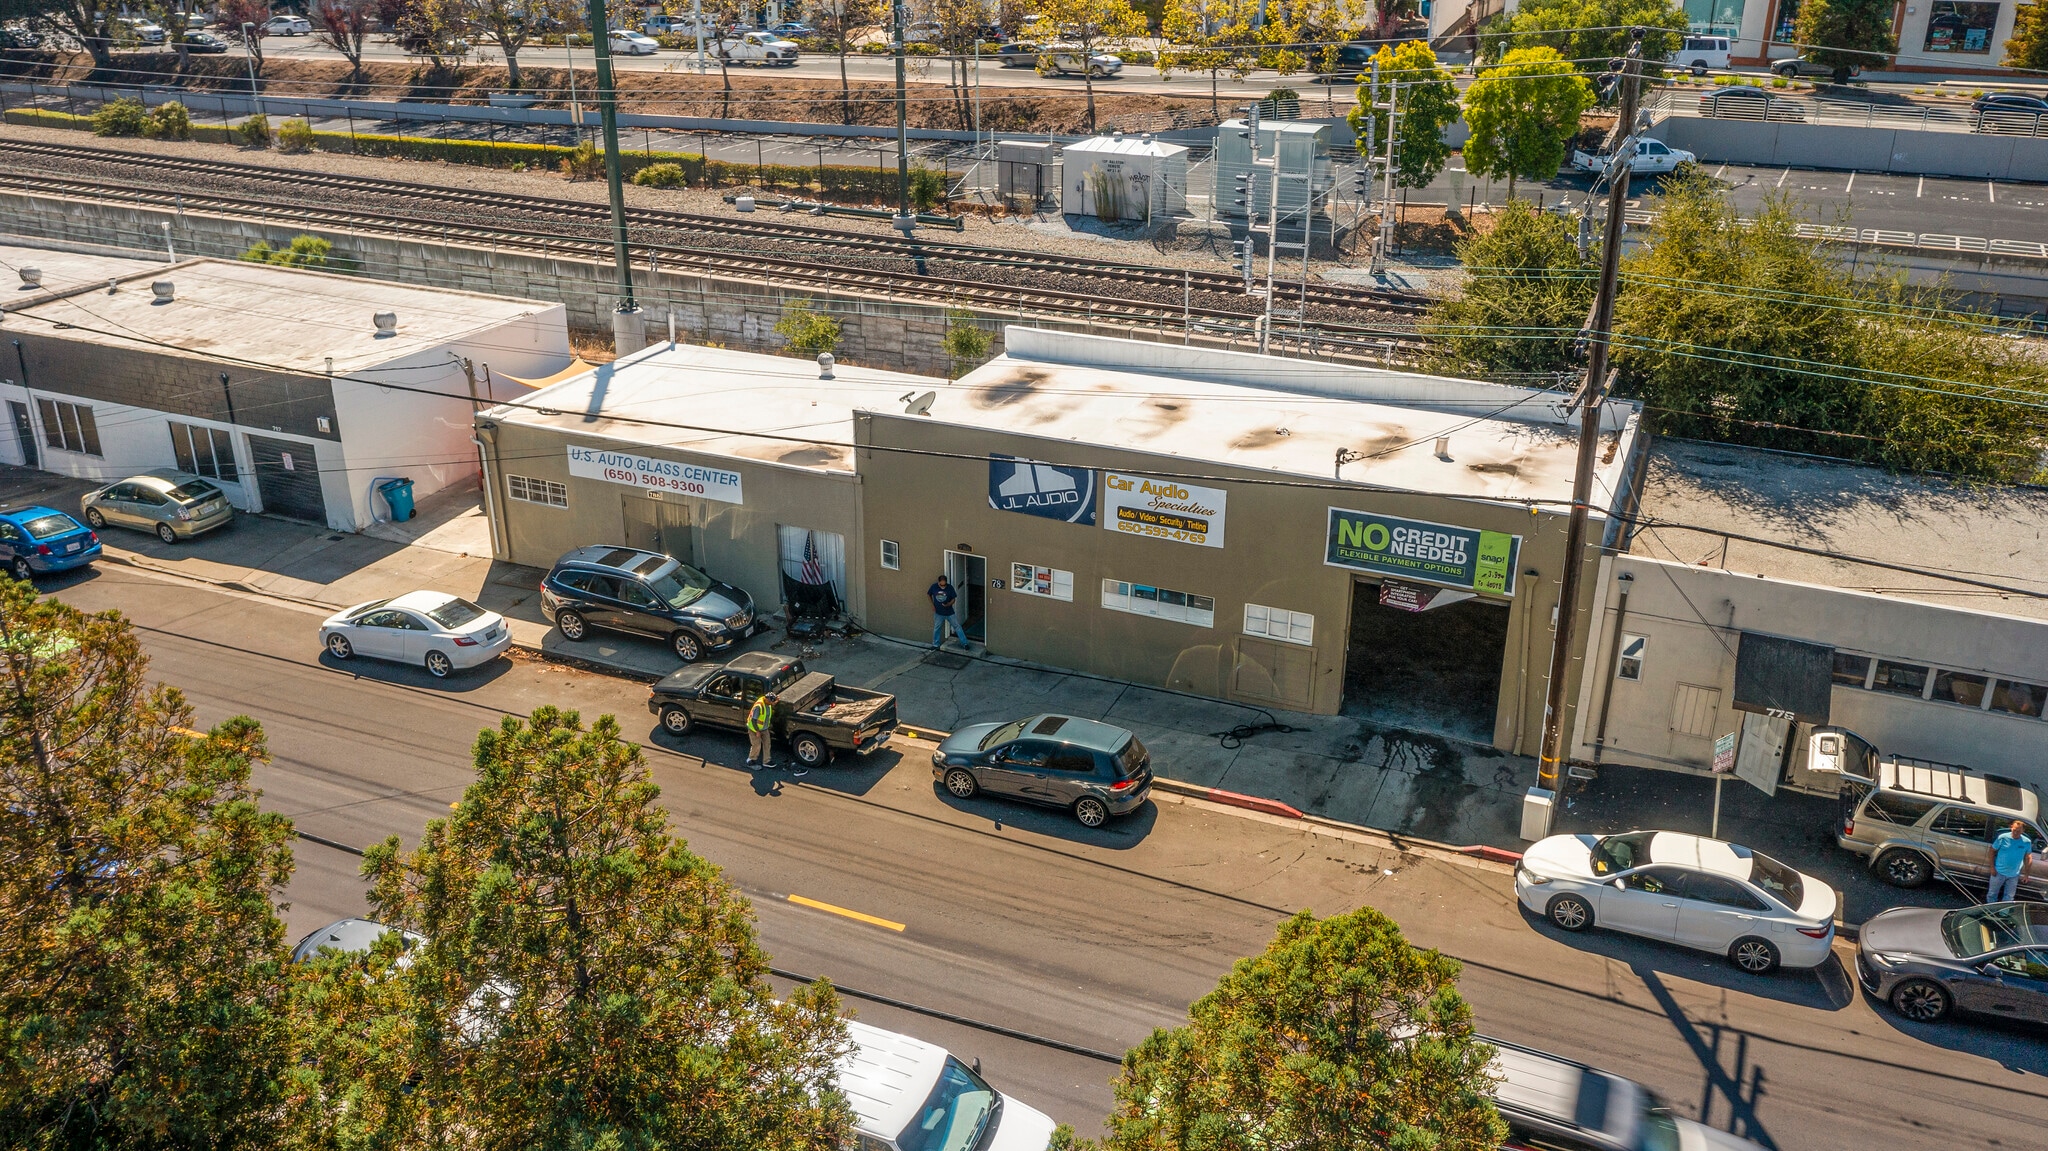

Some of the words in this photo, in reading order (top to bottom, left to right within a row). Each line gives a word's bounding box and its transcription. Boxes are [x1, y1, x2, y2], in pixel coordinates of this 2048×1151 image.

[572, 448, 595, 463] U.S.
[598, 453, 633, 469] AUTO
[637, 459, 680, 477] GLASS
[684, 467, 739, 486] CENTER
[604, 468, 637, 485] (650)
[642, 474, 705, 494] 508-9300
[1106, 475, 1134, 491] Car
[1140, 480, 1189, 500] Audio
[1003, 497, 1023, 509] JL
[1026, 491, 1079, 507] AUDIO
[1147, 496, 1217, 517] Specialties
[1117, 521, 1207, 544] 650-593-4769
[1187, 520, 1207, 533] Tinting
[1338, 518, 1390, 551] NO
[1393, 527, 1469, 551] CREDIT
[1340, 549, 1379, 561] FLEXIBLE
[1382, 556, 1421, 568] PAYMENT
[1424, 564, 1462, 575] OPTIONS
[1391, 541, 1467, 565] NEEDED
[1481, 554, 1505, 564] snap!
[1766, 708, 1795, 721] 775
